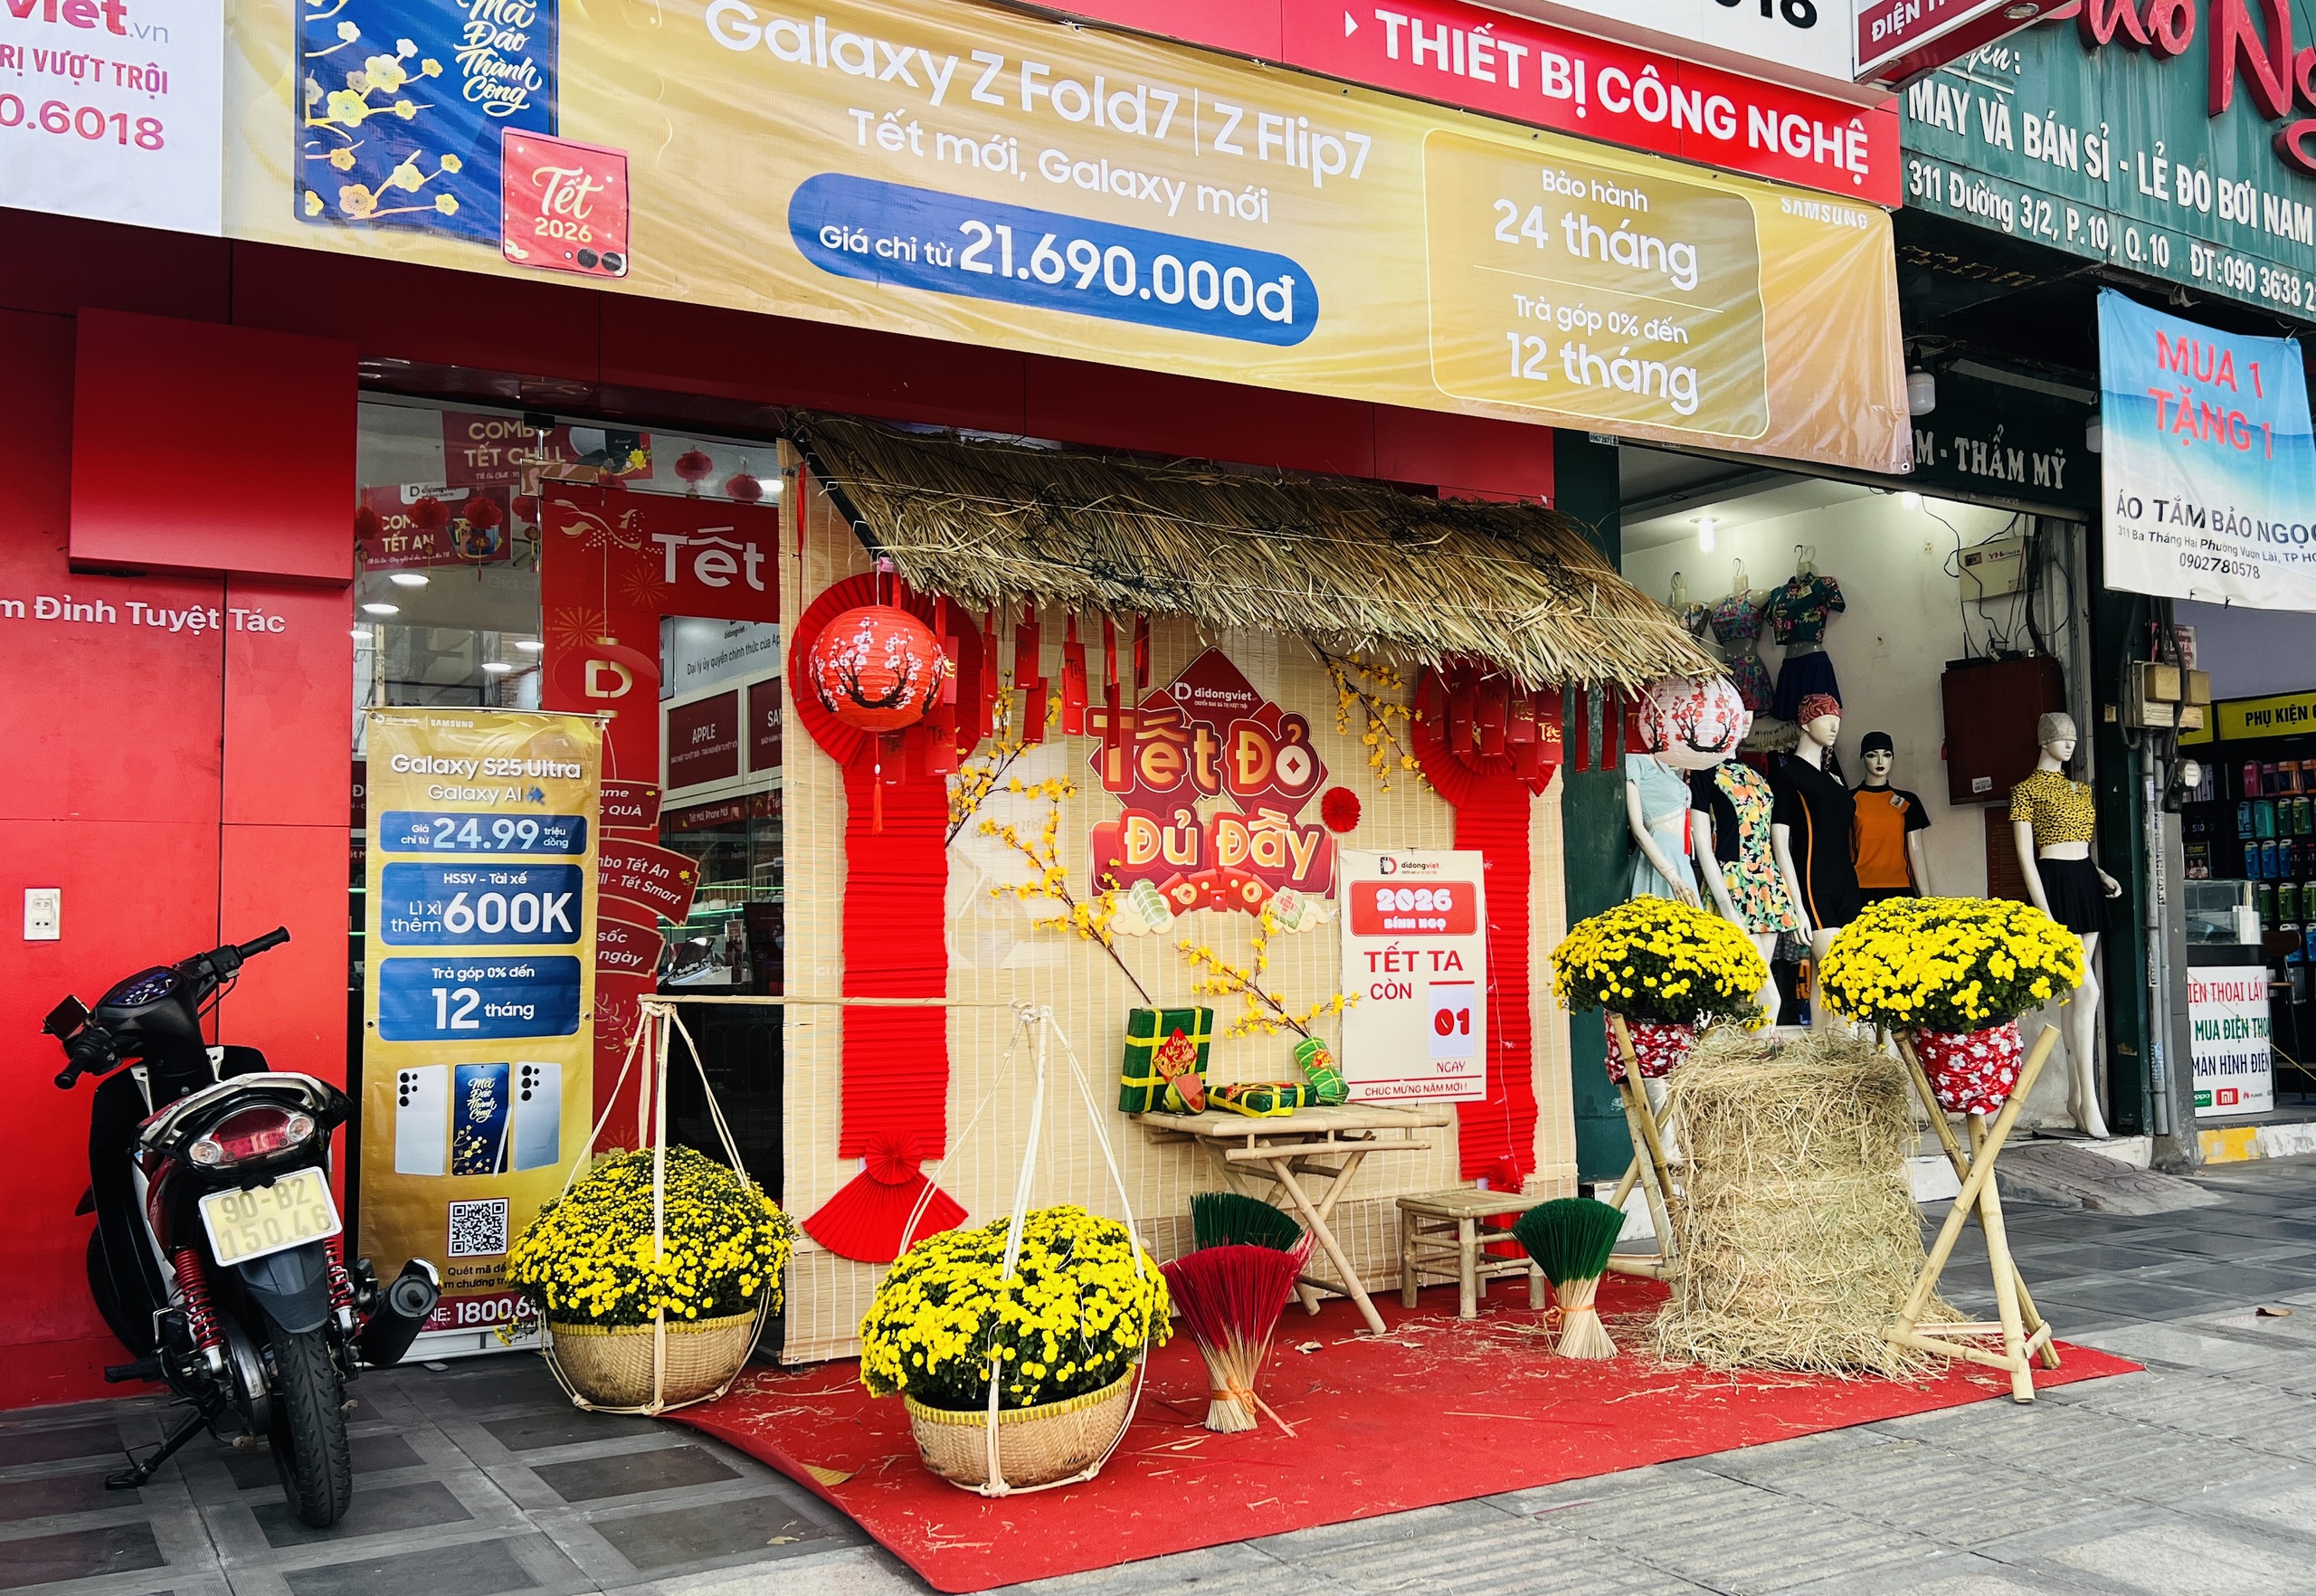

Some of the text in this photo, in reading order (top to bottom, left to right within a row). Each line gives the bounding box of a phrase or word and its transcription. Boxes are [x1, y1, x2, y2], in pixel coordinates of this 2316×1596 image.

[453, 21, 530, 52] Đáo
[1871, 0, 1921, 43] ĐIỆN
[33, 48, 168, 100] VƯỢT TRỘI
[454, 48, 543, 91] Thành
[461, 76, 531, 118] Công
[705, 0, 1372, 187] Galaxy Z Fold7 Z Flip7
[1375, 9, 1870, 185] THIẾT BỊ CÔNG NGHỆ
[847, 108, 1269, 224] Tết mới, Galaxy mới
[1908, 78, 2313, 246] MAY VÀ BÁN SỈ LẺ BƠI NAM
[531, 165, 603, 220] Tết
[1542, 169, 1649, 213] Bảo hành
[534, 216, 593, 244] 2026
[1780, 195, 1869, 232] SAMSUNG
[1494, 199, 1698, 291] 24 tháng
[1908, 160, 1942, 204] 311
[1949, 170, 2016, 234] Đường
[2019, 194, 2060, 242] 3/2,
[2066, 206, 2117, 258] P.10,
[2125, 226, 2170, 270] Q.10
[2260, 266, 2302, 308] 3638
[819, 220, 1296, 325] Giá chỉ từ 21.690.000đ
[1513, 293, 1689, 346] Trả góp 0% đến
[1506, 331, 1699, 416] 12 tháng
[2155, 330, 2264, 399] MUA 1
[2147, 385, 2273, 460] TẶNG 1
[463, 442, 501, 468] TẾT
[1954, 424, 2067, 490] THẨM MỸ
[2116, 489, 2253, 538] ÁO TẮM BẢO
[382, 531, 409, 553] TẾT
[651, 526, 765, 592] Tết
[2117, 525, 2131, 538] 311
[2131, 529, 2145, 541] Ba
[2148, 531, 2182, 547] Tháng
[2184, 536, 2198, 548] Hai
[2199, 538, 2238, 557] Phường
[2239, 546, 2261, 560] Vườn
[2283, 553, 2299, 563] TP
[2178, 552, 2261, 579] 0902780578
[33, 594, 117, 624] Đỉnh
[125, 602, 221, 636] Tuyệt
[229, 608, 287, 633] Tác
[430, 718, 474, 728] SAMSUNG
[2245, 709, 2273, 727] PHỤ
[2275, 703, 2309, 725] KIỆN
[691, 723, 717, 746] APPLE
[390, 754, 582, 780] Galaxy S25 Ultra
[1092, 715, 1312, 790] Tết Đỏ
[428, 784, 523, 805] Galaxy AI
[609, 803, 643, 817] QUÀ
[401, 832, 569, 849] chỉ từ đồng
[412, 817, 567, 850] Giá 24.99 triệu
[1124, 808, 1320, 881] Đủ Đầy
[443, 869, 528, 885] HSSV Tài xế
[625, 856, 670, 879] Tết An
[621, 873, 682, 906] Tết Smart
[1375, 888, 1453, 912] 2026
[390, 917, 441, 934] thêm
[409, 891, 574, 934] Lì xì 600K
[1383, 915, 1447, 932] BÍNH NGỌ
[597, 927, 629, 944] sốc
[432, 964, 536, 983] Trả góp 0% đến
[599, 949, 644, 966] ngày
[1363, 940, 1465, 974] TẾT TA
[1370, 978, 1413, 1001] CÒN
[2210, 981, 2245, 1006] THOẠI
[432, 987, 536, 1031] 12 tháng
[1433, 1007, 1470, 1037] 01
[2195, 1013, 2249, 1043] MUA ĐIỆN
[2219, 1049, 2247, 1077] HÌNH
[2250, 1048, 2270, 1076] ĐIỆN
[1364, 1080, 1463, 1097] CHÚC MỪNG NĂM MỚI
[219, 1177, 312, 1224] 90-B2
[221, 1203, 333, 1259] 150.46
[447, 1264, 492, 1277] Quét mã
